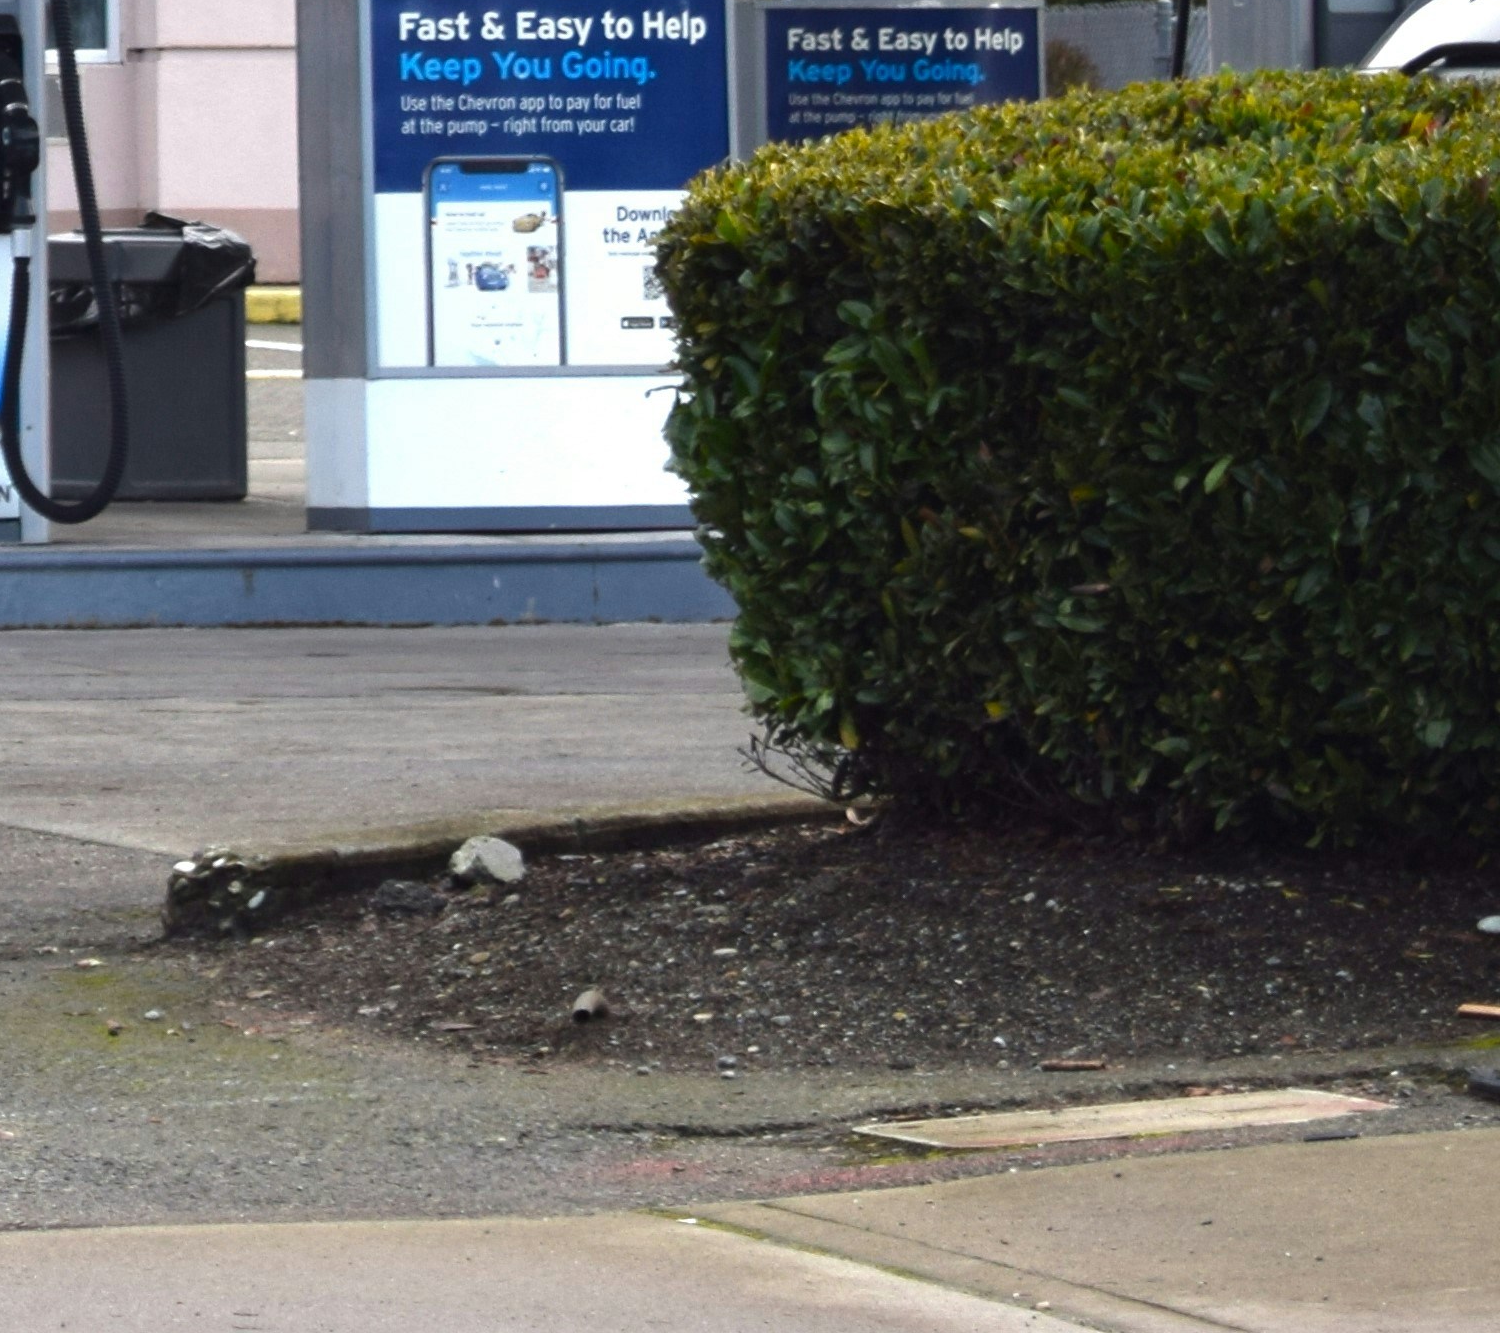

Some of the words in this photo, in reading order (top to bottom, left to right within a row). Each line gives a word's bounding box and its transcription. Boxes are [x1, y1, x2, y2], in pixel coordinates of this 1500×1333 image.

[399, 12, 470, 41] Fast
[480, 11, 505, 40] &
[515, 11, 593, 46] Easy
[602, 11, 634, 40] to
[643, 9, 707, 45] Help
[787, 28, 843, 51] Fast
[851, 28, 869, 51] &
[878, 28, 938, 55] Easy
[944, 27, 969, 51] to
[974, 27, 1024, 55] Help
[399, 51, 482, 86] Keep
[492, 51, 550, 80] You
[562, 50, 657, 85] Going.
[788, 59, 853, 85] Keep
[860, 59, 905, 81] You
[913, 58, 986, 85] Going.
[400, 95, 427, 111] Use
[431, 95, 454, 111] the
[458, 94, 516, 111] Chevron
[519, 97, 545, 113] app
[549, 95, 563, 111] to
[566, 97, 590, 113] pay
[594, 94, 613, 110] for
[616, 93, 641, 110] fuel
[788, 93, 808, 106] Use
[812, 93, 830, 106] the
[832, 93, 878, 106] Chevron
[880, 95, 900, 107] app
[903, 93, 914, 105] to
[917, 95, 935, 107] pay
[937, 92, 952, 105] for
[401, 120, 416, 134] at
[420, 119, 443, 134] the
[447, 121, 487, 136] pump
[503, 118, 537, 136] right
[541, 117, 573, 134] from
[577, 120, 606, 136] your
[610, 117, 635, 133] car!
[803, 112, 822, 124] the
[824, 113, 856, 126] pump
[603, 228, 631, 243] the
